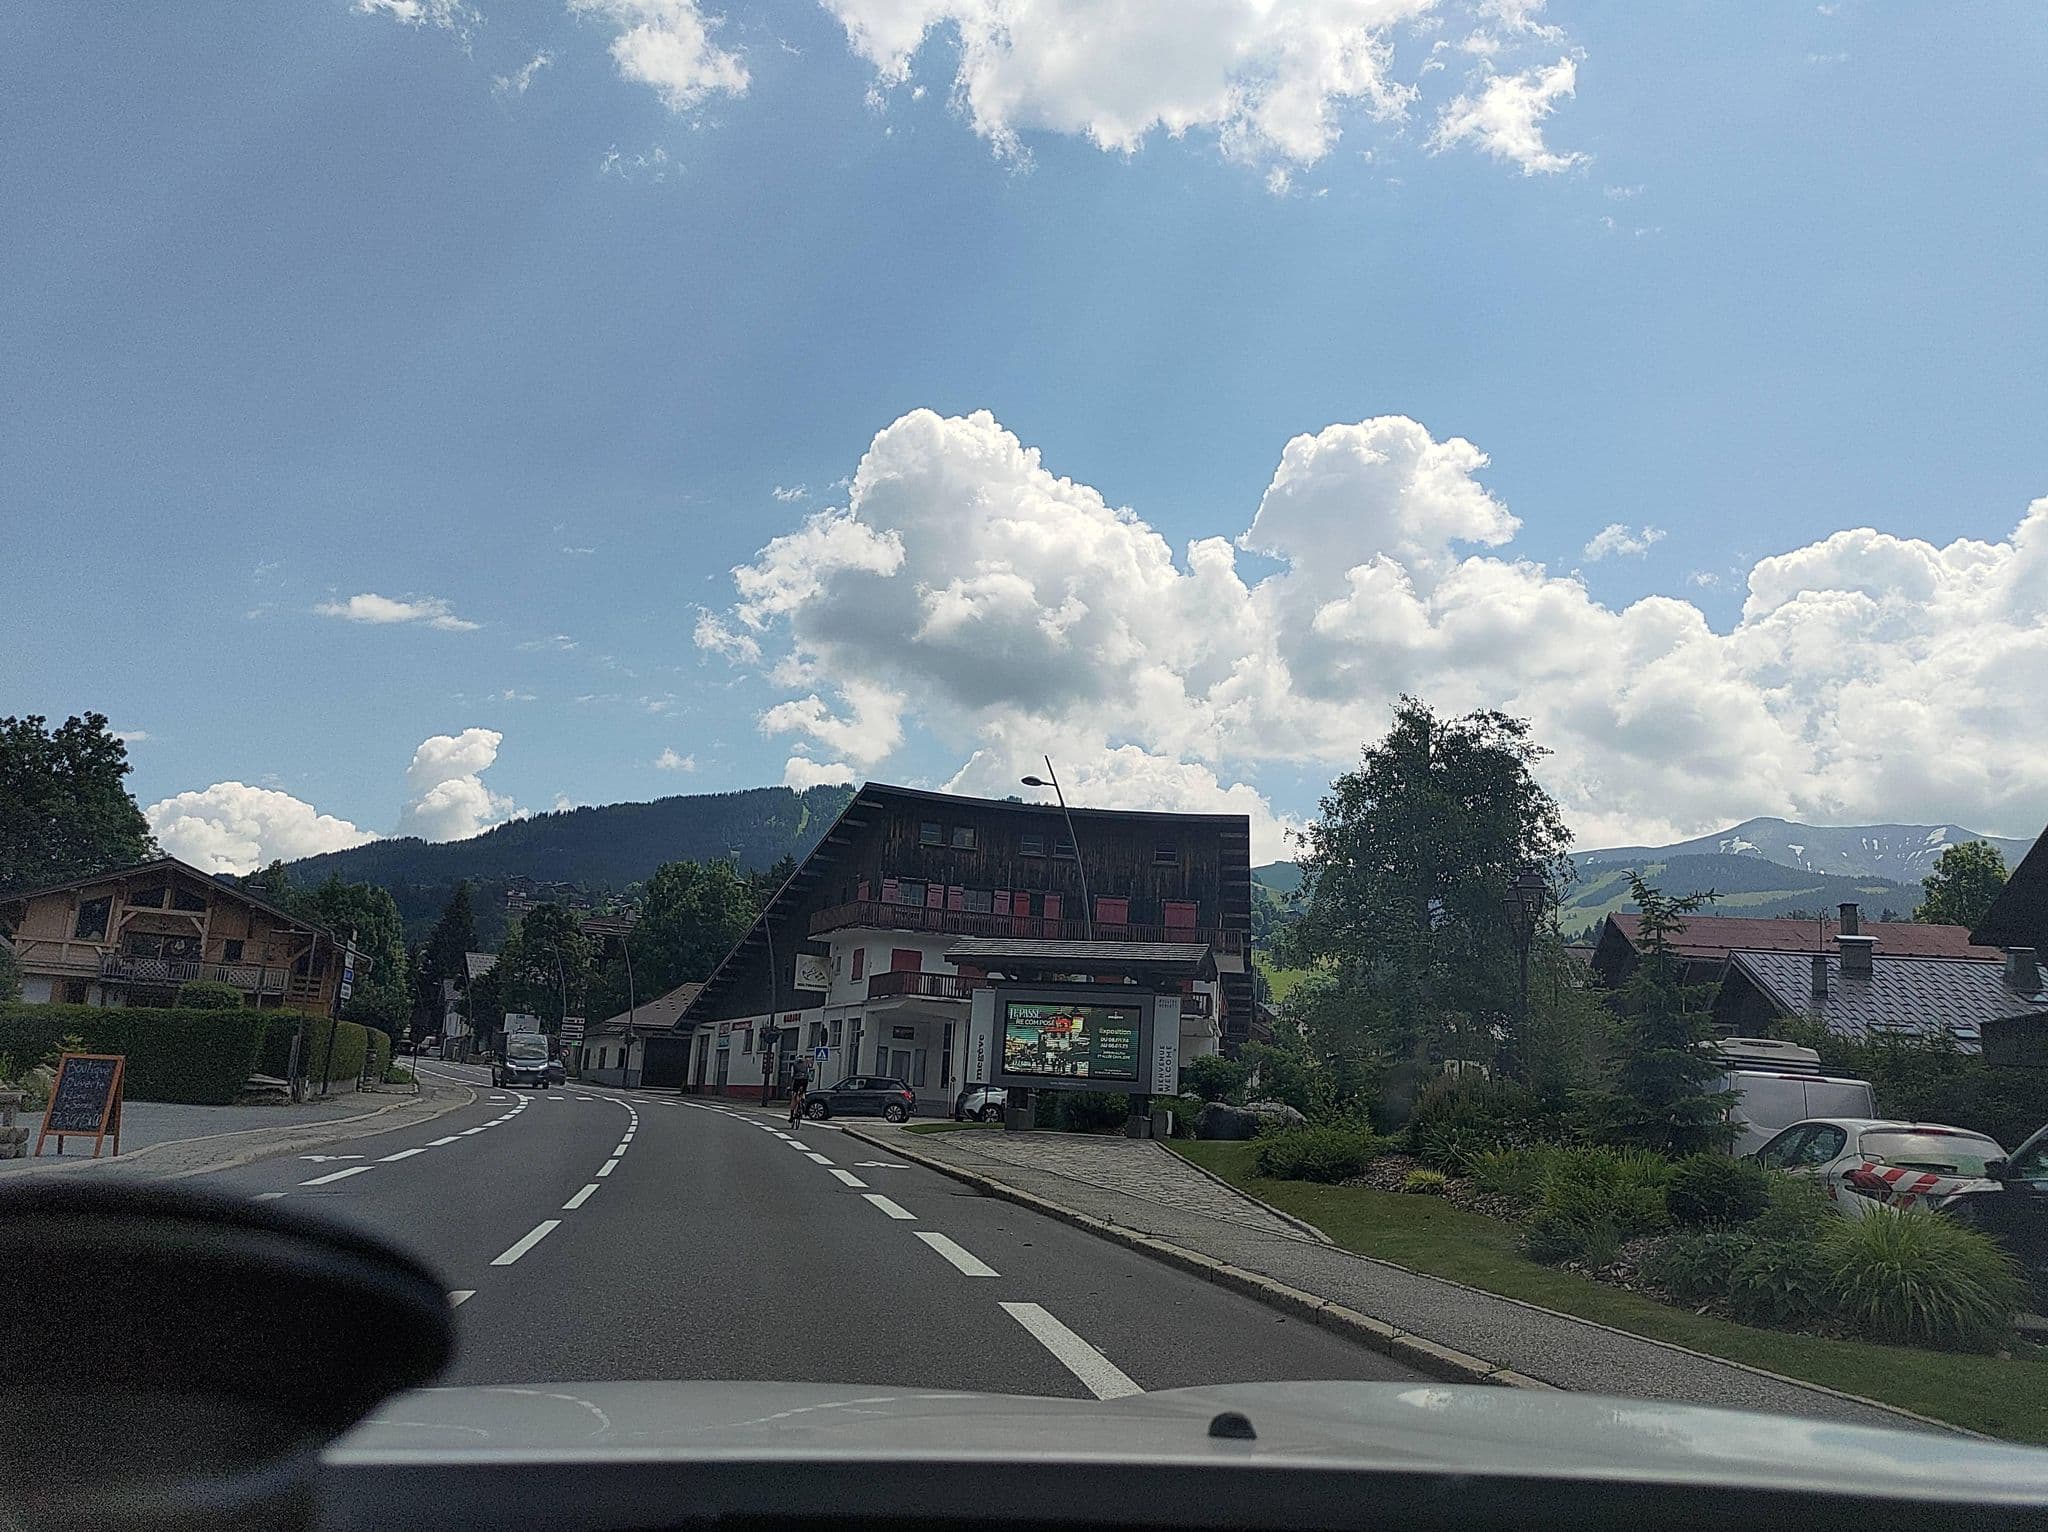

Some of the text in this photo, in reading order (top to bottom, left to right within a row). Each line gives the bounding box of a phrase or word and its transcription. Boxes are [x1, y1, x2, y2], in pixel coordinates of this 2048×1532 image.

[64, 1077, 105, 1090] Ouverte
[67, 1060, 110, 1078] Boutique
[1157, 1045, 1165, 1092] BIENVENUE
[1164, 1045, 1173, 1093] WELCOME
